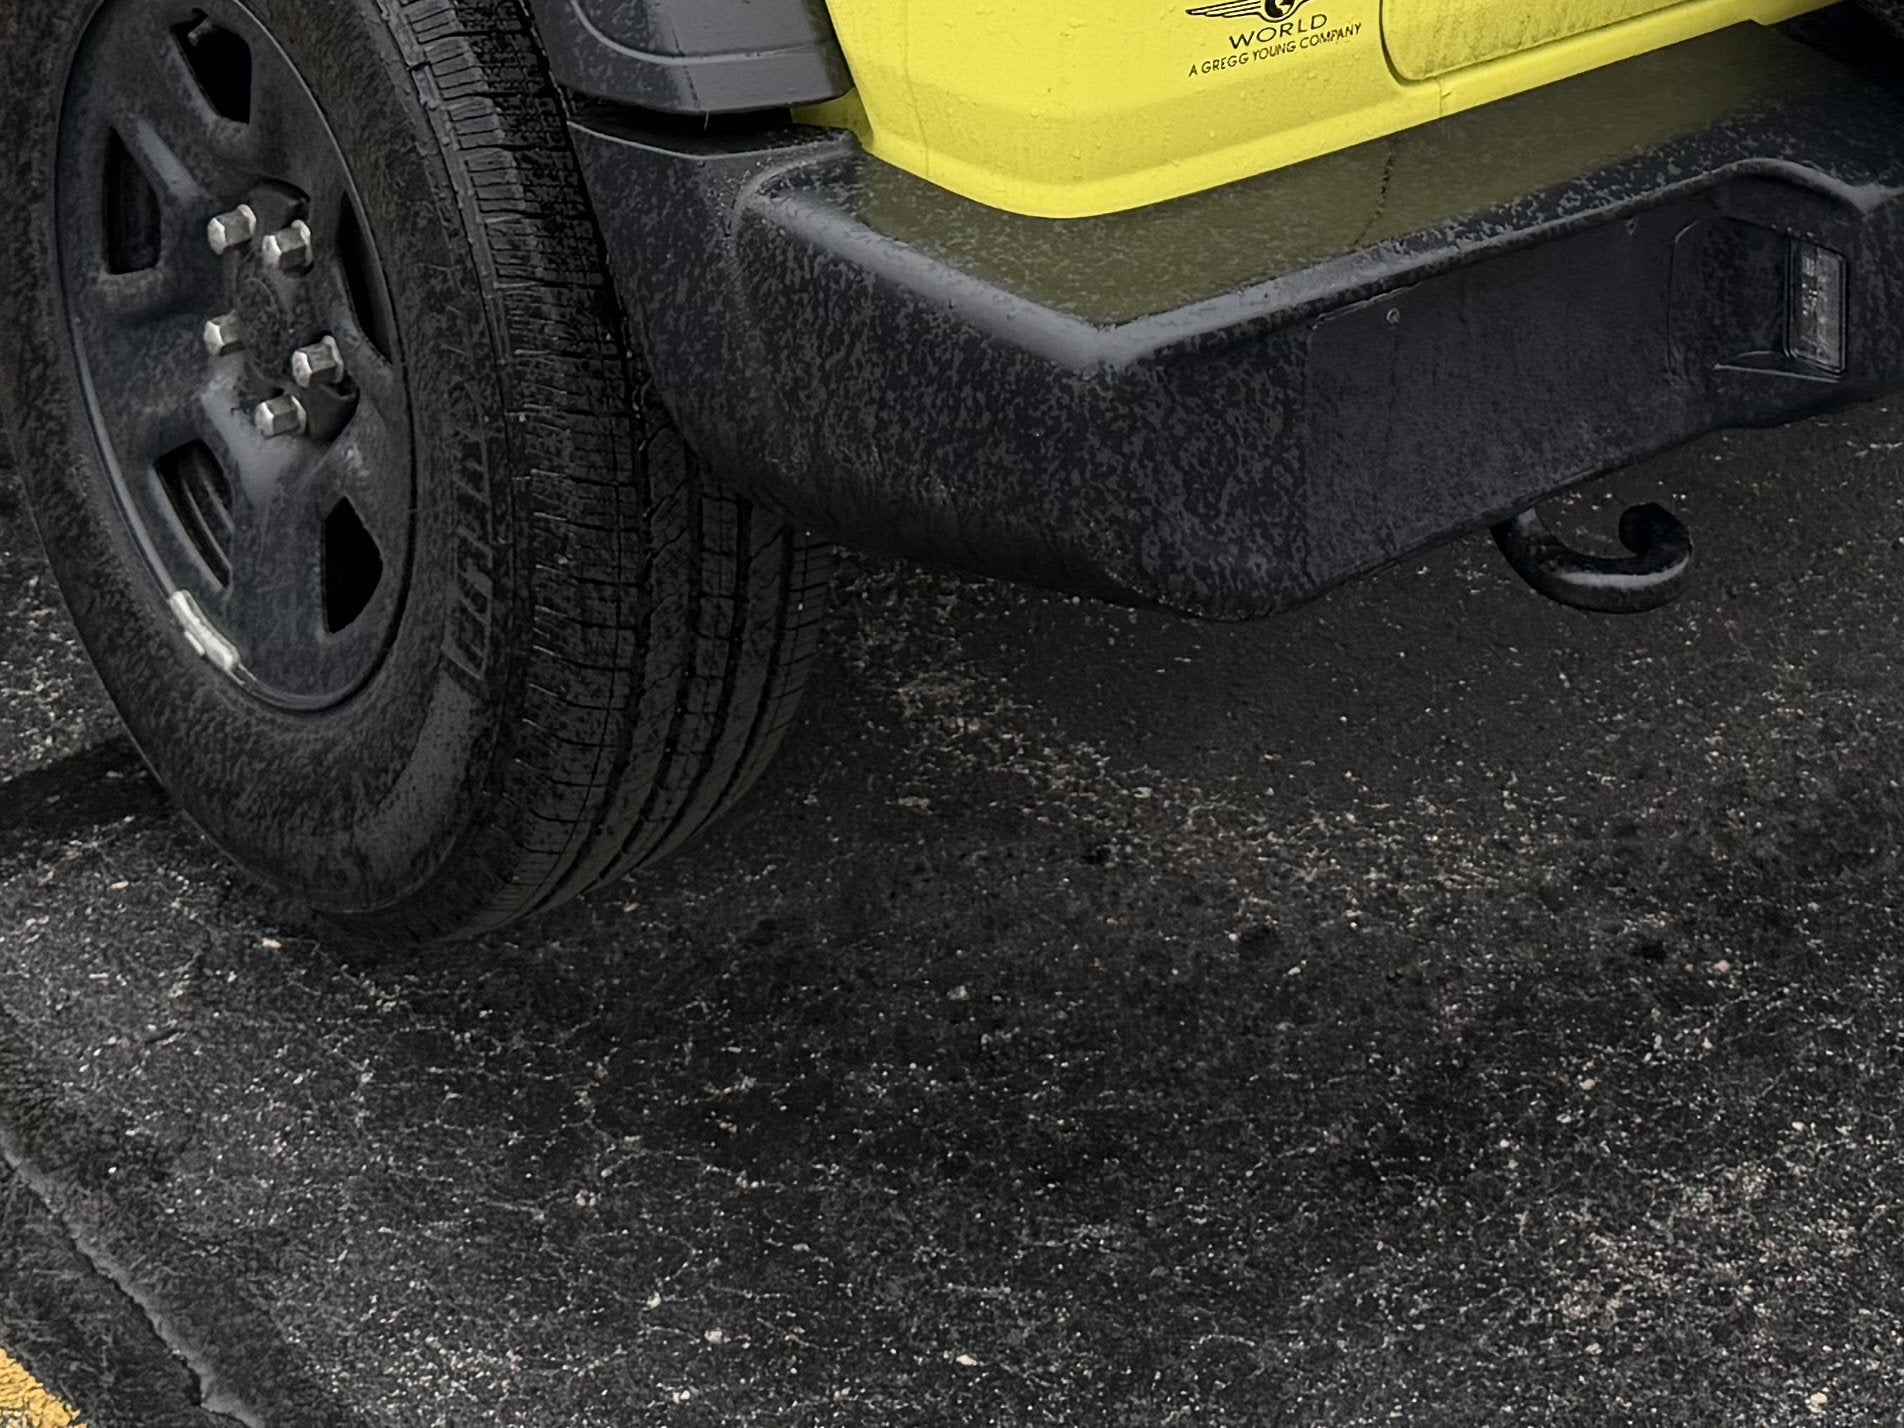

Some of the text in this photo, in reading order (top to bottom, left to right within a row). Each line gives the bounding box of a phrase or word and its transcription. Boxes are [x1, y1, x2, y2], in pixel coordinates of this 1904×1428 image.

[1188, 22, 1363, 77] A GREGG YOUNG COMPANY
[1228, 13, 1328, 49] WORLD
